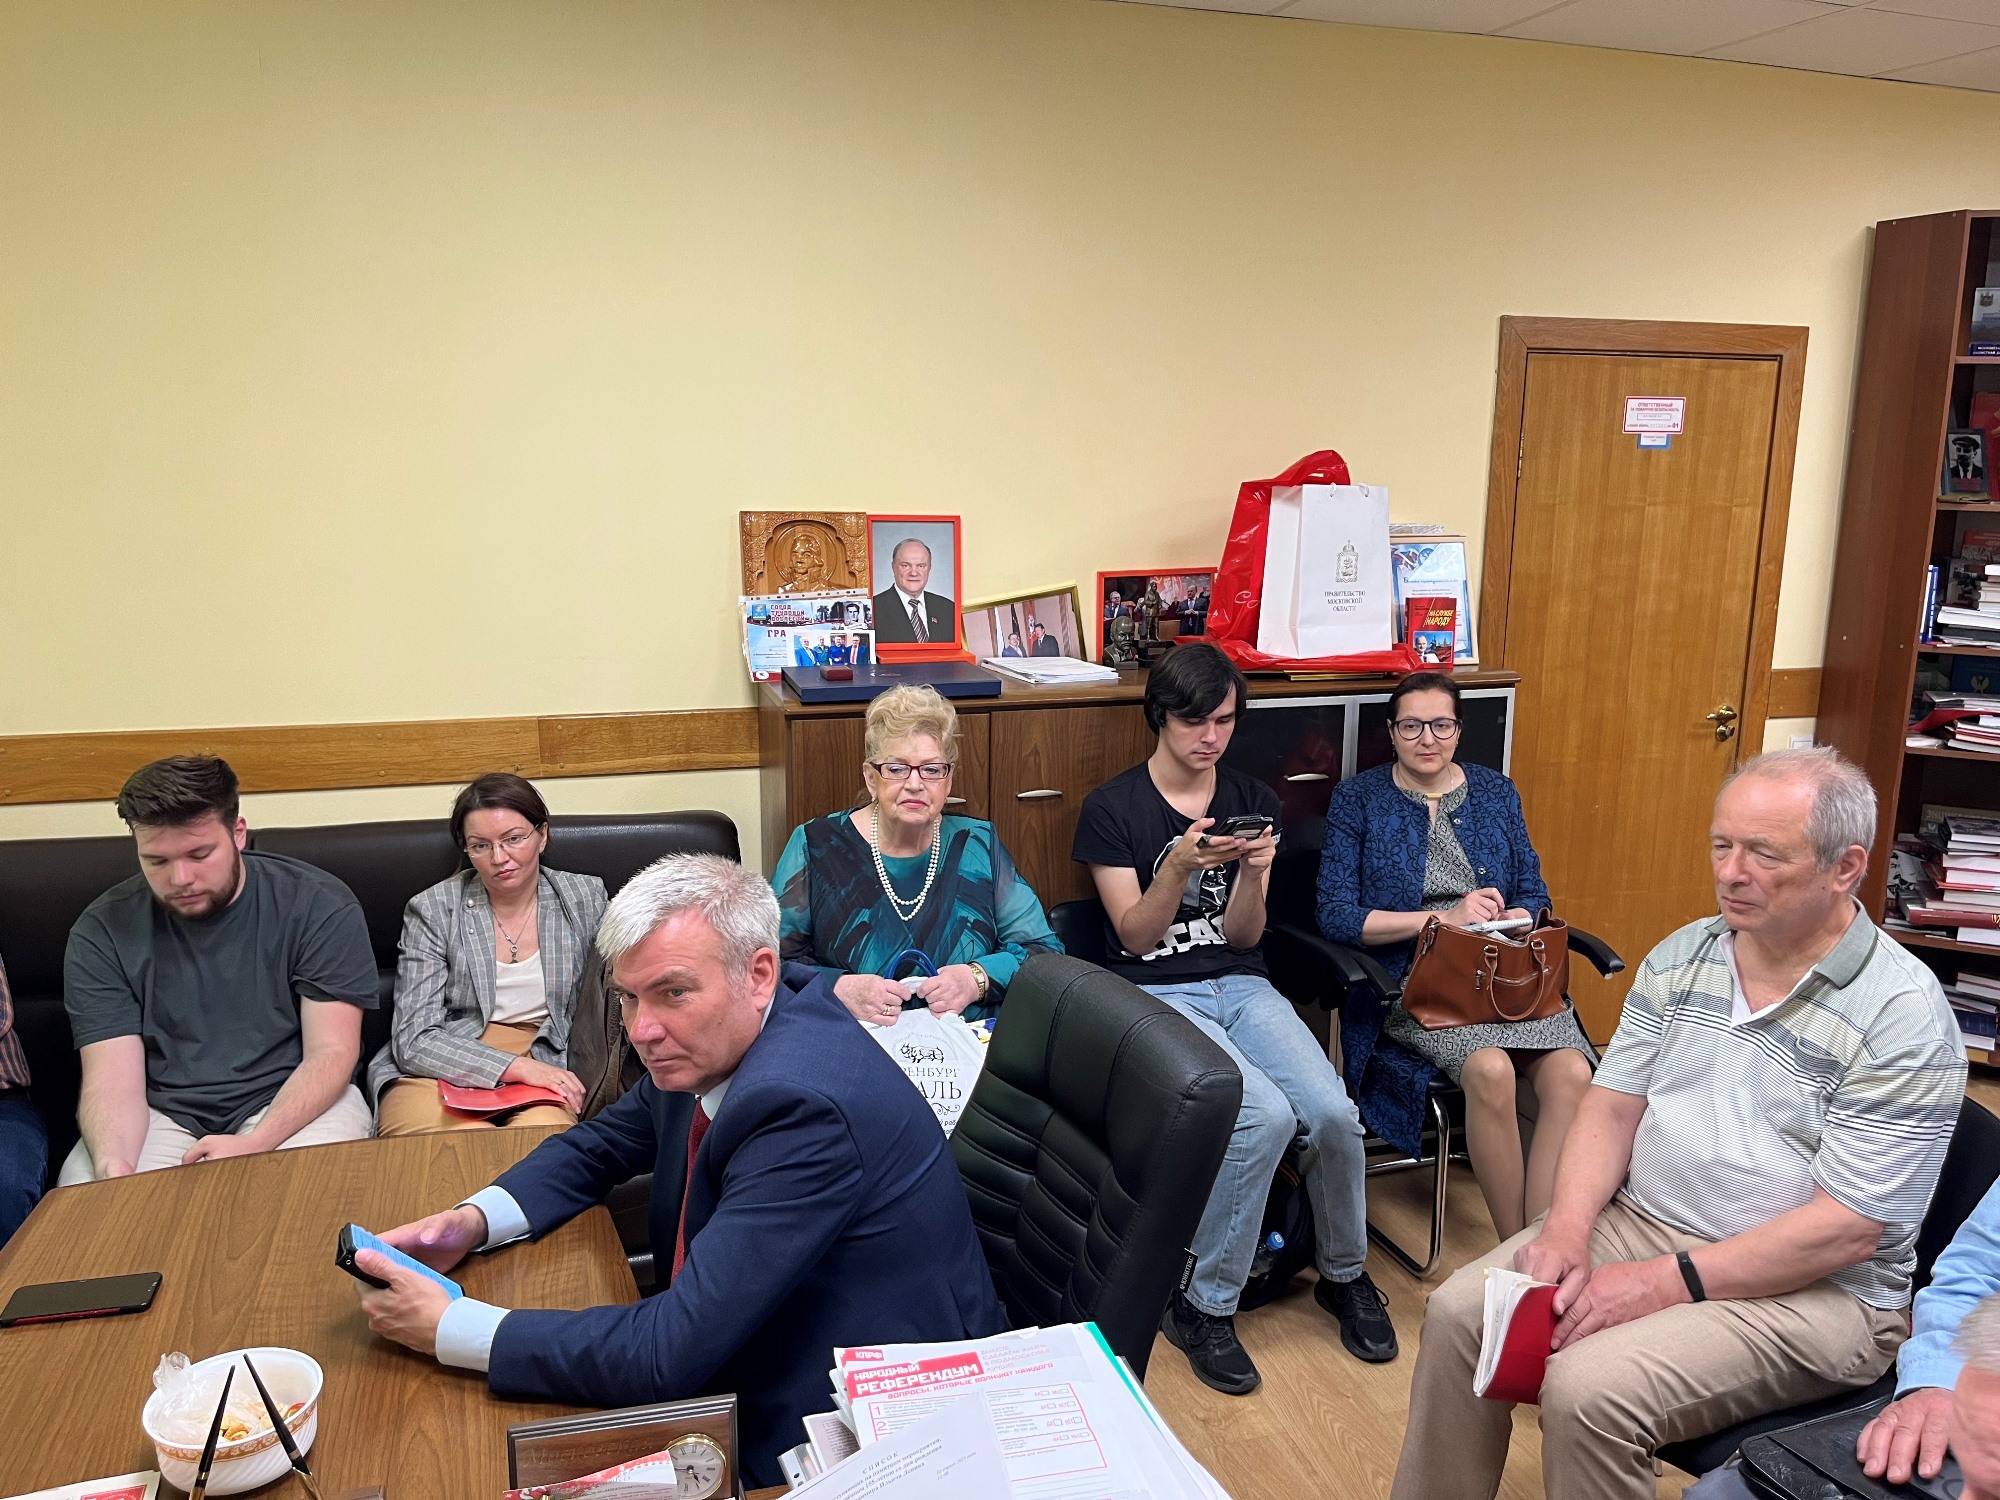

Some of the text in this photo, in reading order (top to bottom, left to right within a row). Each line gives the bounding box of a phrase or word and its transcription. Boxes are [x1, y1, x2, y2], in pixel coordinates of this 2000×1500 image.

[1425, 617, 1451, 626] НАРОДУ
[767, 629, 786, 638] ГРА
[902, 1066, 960, 1078] ЕНБУРГ
[917, 1080, 962, 1100] АЛЬ
[855, 1351, 882, 1359] КПРФ
[981, 1346, 1009, 1355] ВМЕСТЕ
[982, 1344, 1047, 1360] СДЕЛАЕМ ЖИЗНЬ
[990, 1348, 1050, 1365] ПОДМОСКОВЬЕ
[853, 1362, 920, 1381] НАРОДНЫЙ
[856, 1363, 979, 1395] РЕФЕРЕНДУМ
[933, 1379, 973, 1392] КОТОРЫЕ
[975, 1370, 1013, 1383] ВОЛНУЮТ
[1015, 1362, 1054, 1375] КАЖДОГО
[873, 1406, 881, 1416] 1
[875, 1421, 888, 1431] 2
[914, 1445, 943, 1467] рождения
[903, 1461, 925, 1476] Ленина
